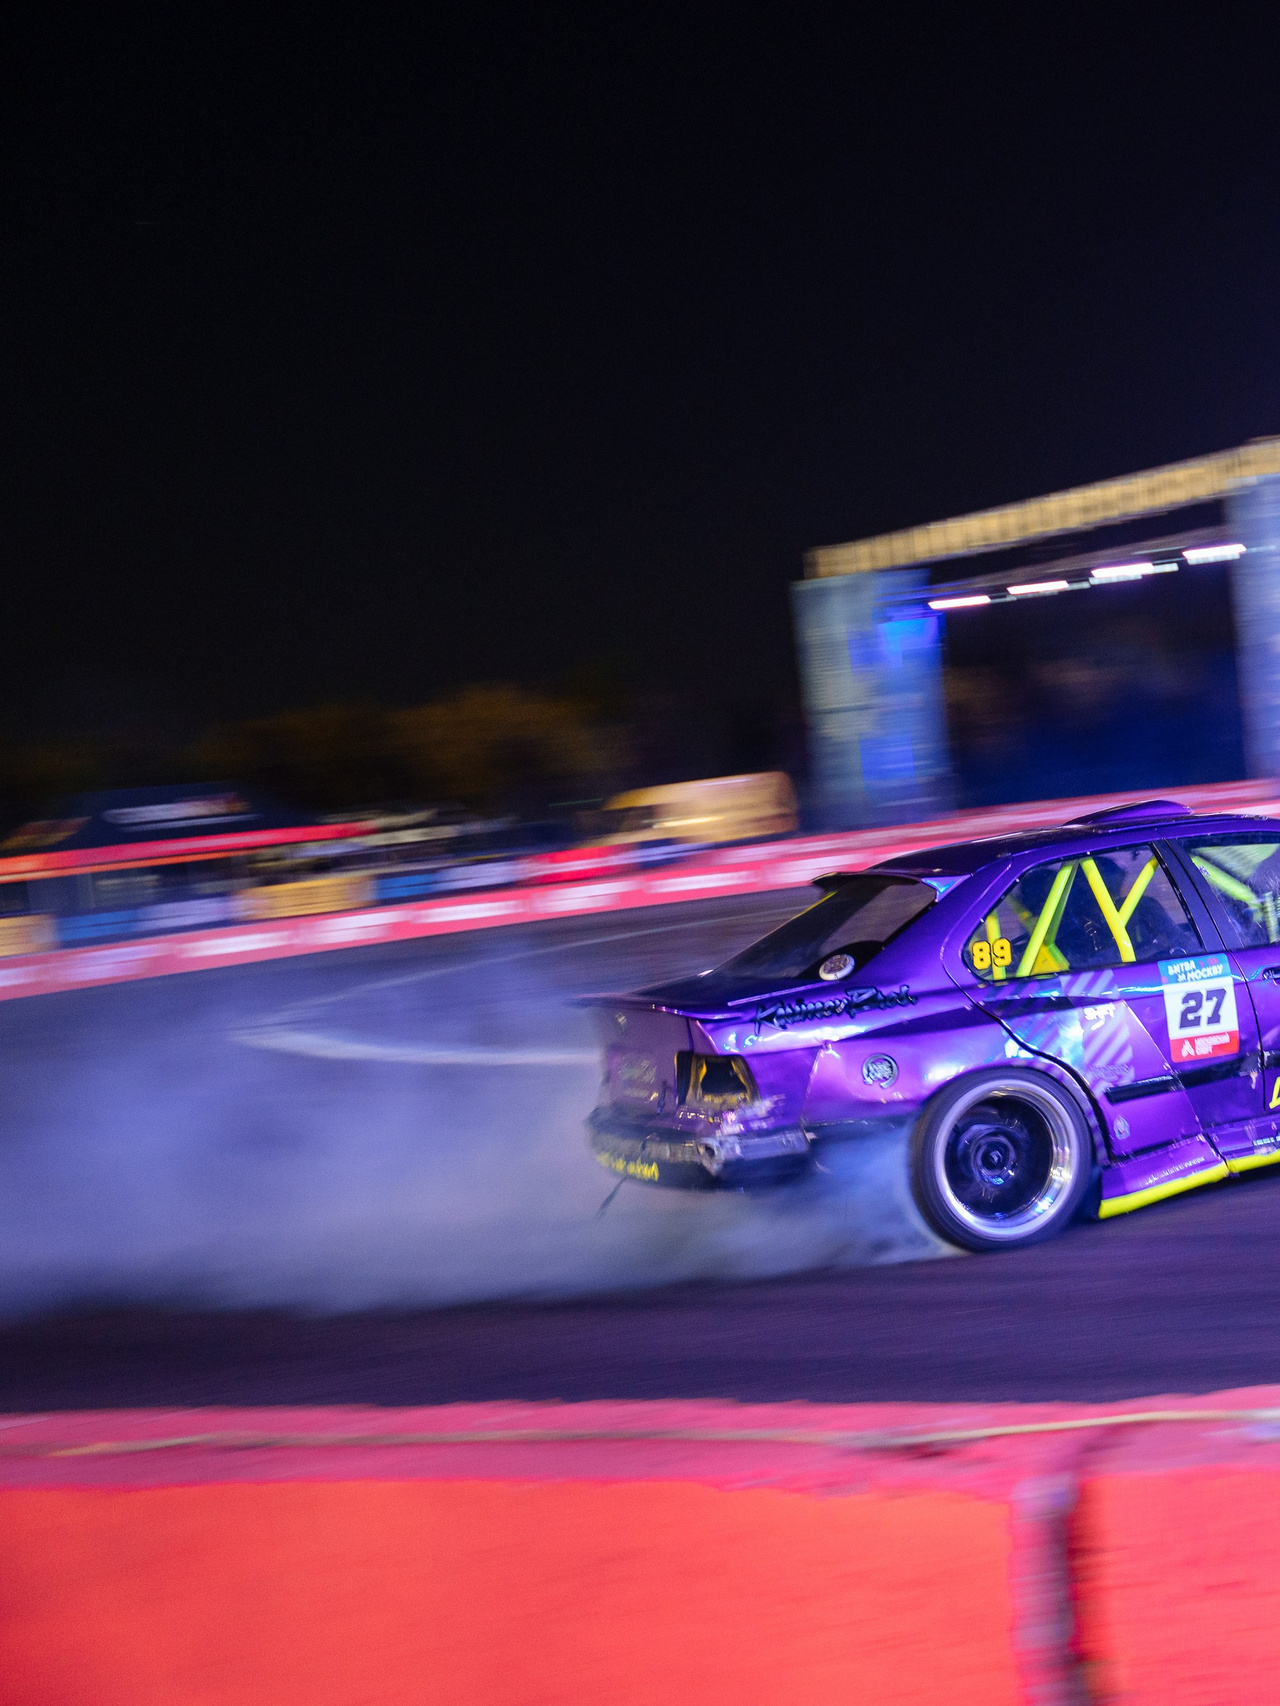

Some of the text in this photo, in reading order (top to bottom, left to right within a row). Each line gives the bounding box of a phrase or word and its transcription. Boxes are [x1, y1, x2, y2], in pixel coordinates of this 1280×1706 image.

[972, 937, 1012, 970] 89
[1167, 960, 1196, 976] БИТВА
[1186, 964, 1223, 982] МОСКВУ
[1179, 988, 1227, 1030] 27
